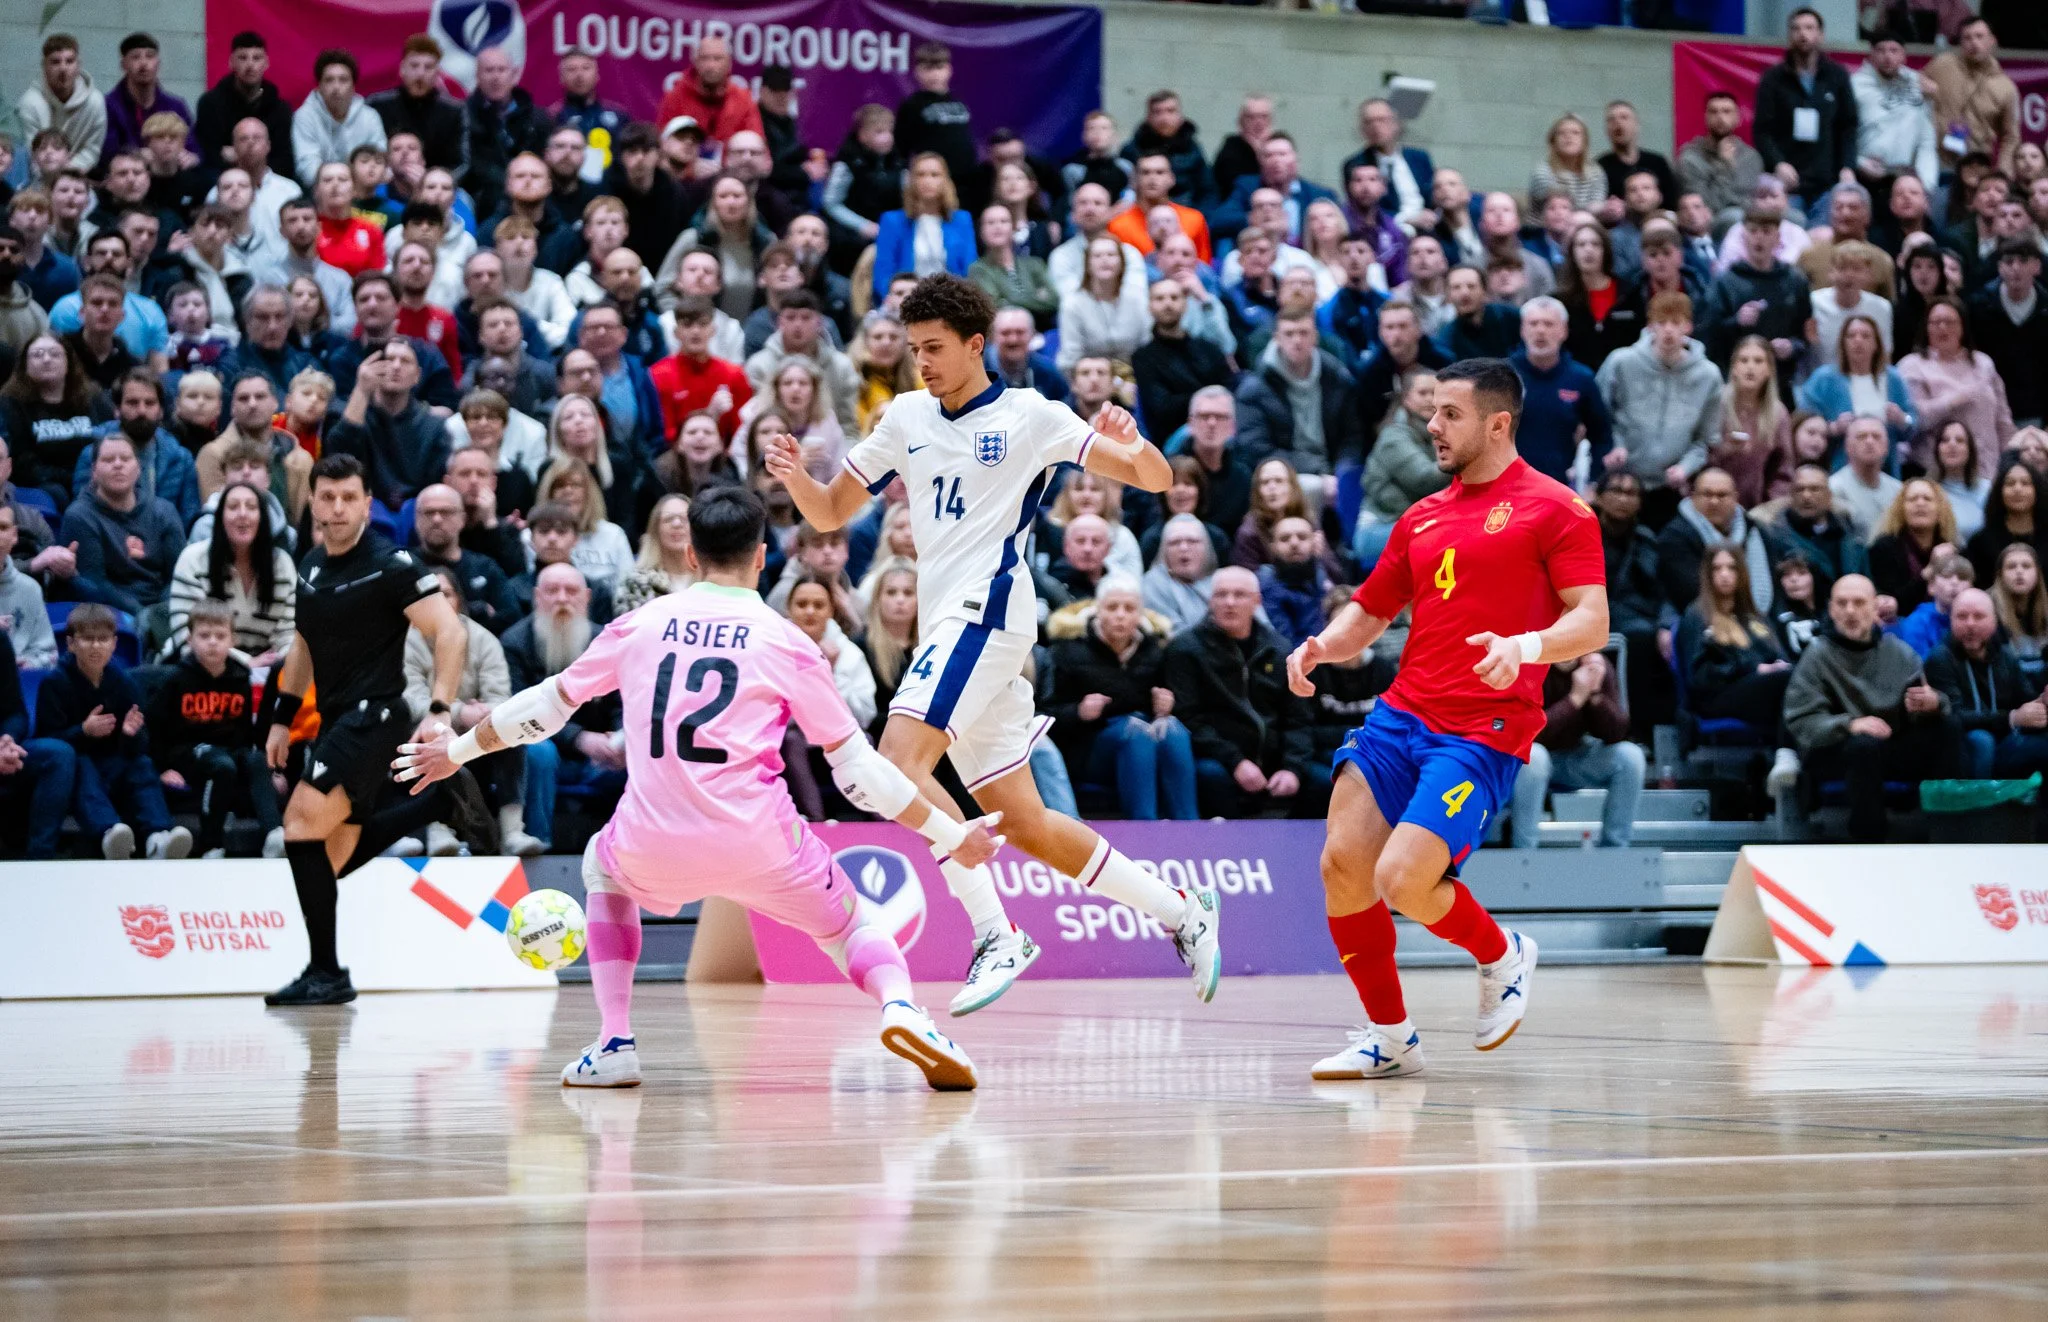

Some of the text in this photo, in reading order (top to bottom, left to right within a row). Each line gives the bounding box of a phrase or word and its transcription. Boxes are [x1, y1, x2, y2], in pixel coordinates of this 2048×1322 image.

[932, 476, 966, 521] 14
[1434, 547, 1456, 600] 4
[662, 617, 750, 650] ASIER
[904, 644, 939, 681] 4
[650, 651, 739, 764] 12
[1441, 780, 1475, 819] 4
[950, 858, 1274, 898] UGHOUGH
[179, 910, 286, 930] ENGLAND
[1055, 903, 1167, 942] SPOR
[185, 931, 271, 951] FUTSAL
